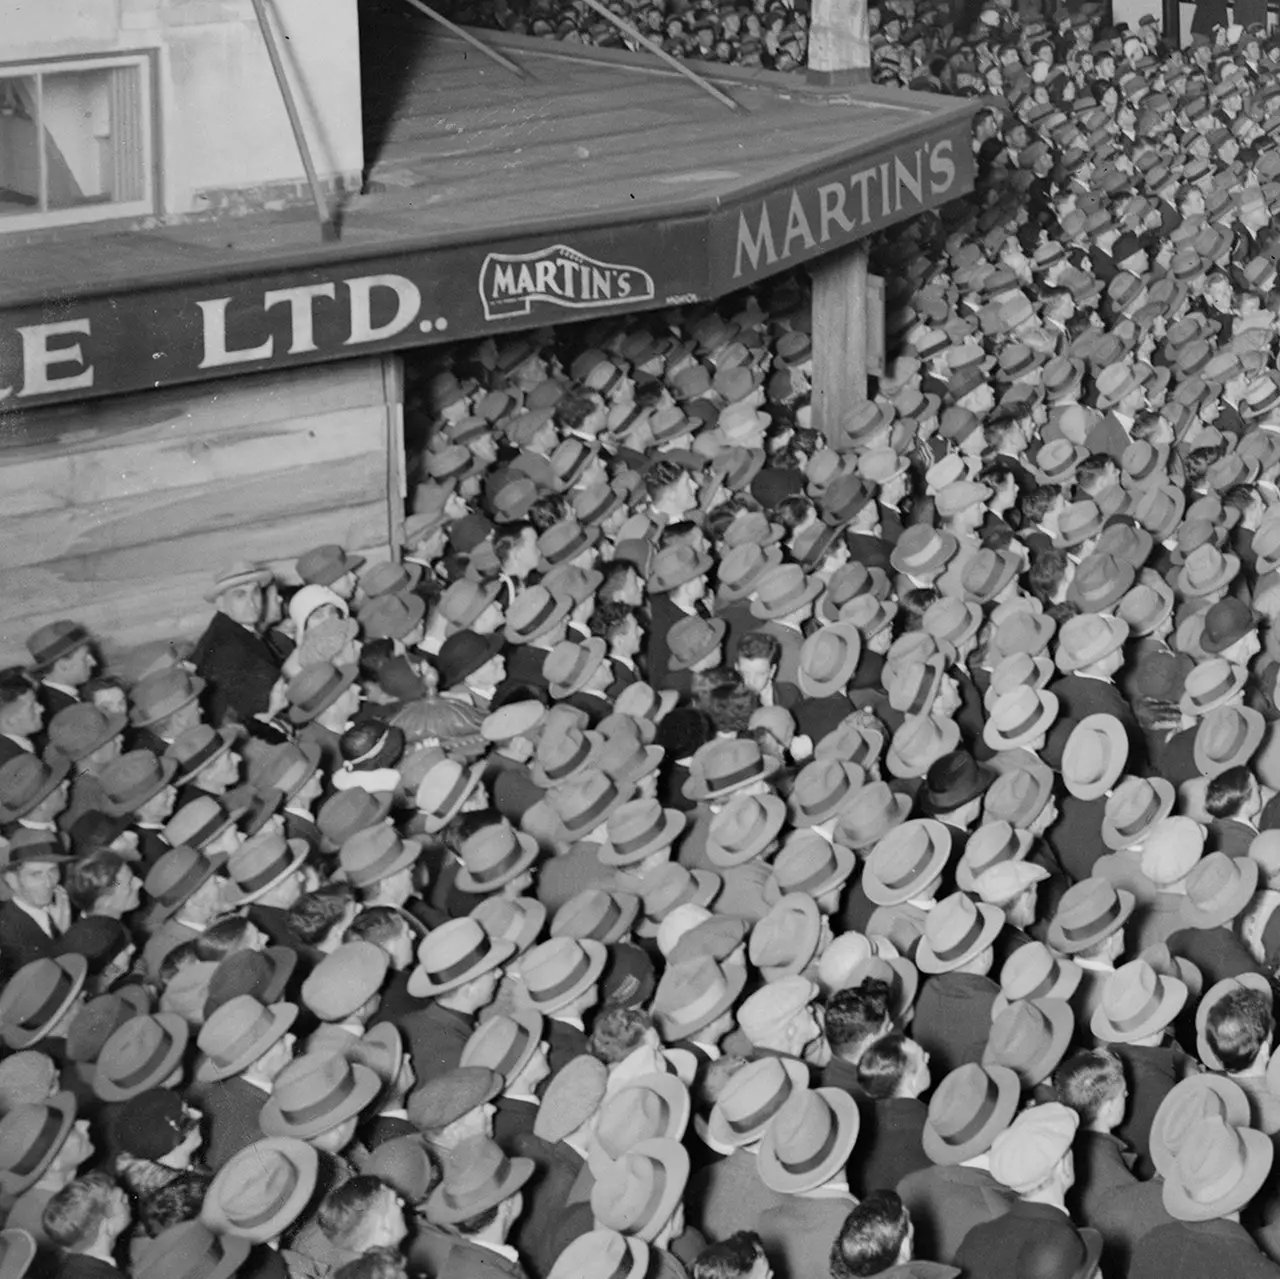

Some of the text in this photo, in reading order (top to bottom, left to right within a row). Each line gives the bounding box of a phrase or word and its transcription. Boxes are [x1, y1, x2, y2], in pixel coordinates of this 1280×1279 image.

[733, 141, 955, 278] MARTIN'S
[492, 258, 631, 299] MARTIN'S
[0, 319, 94, 401] E
